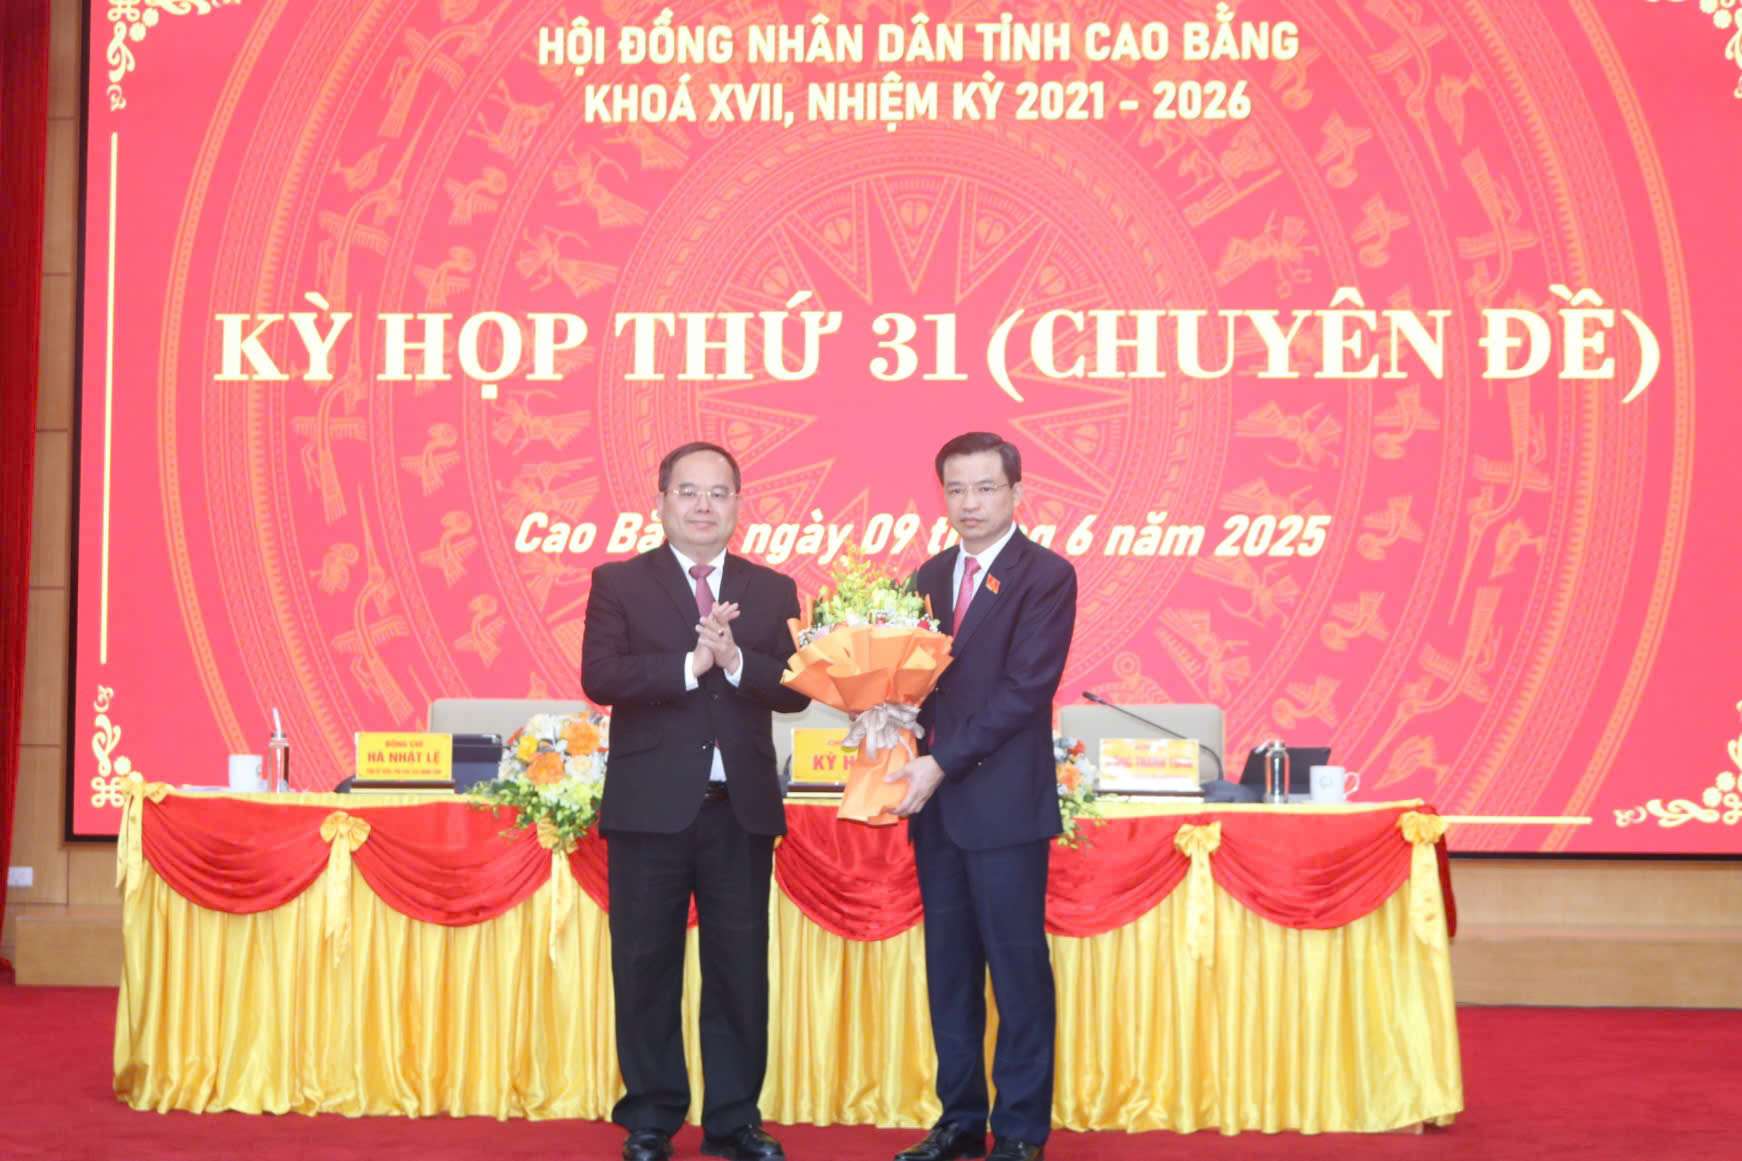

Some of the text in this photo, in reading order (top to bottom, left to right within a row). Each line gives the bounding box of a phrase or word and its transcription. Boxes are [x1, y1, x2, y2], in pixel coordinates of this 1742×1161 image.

[538, 1, 1299, 77] HỘI ĐỒNG NHÂN DÂN TỈNH CAO BẰNG
[584, 70, 1251, 132] KHOÁ XVII, NHIỆM KỲ 2021 - 2026
[213, 284, 1660, 404] KỲ HỌP THỨ 31 (CHUYÊN ĐỀ)
[514, 511, 597, 553] Cao
[741, 509, 855, 565] ngày
[859, 513, 921, 555] 09
[1065, 514, 1098, 556] 6
[1103, 511, 1205, 557] năm
[1214, 514, 1332, 557] 2025
